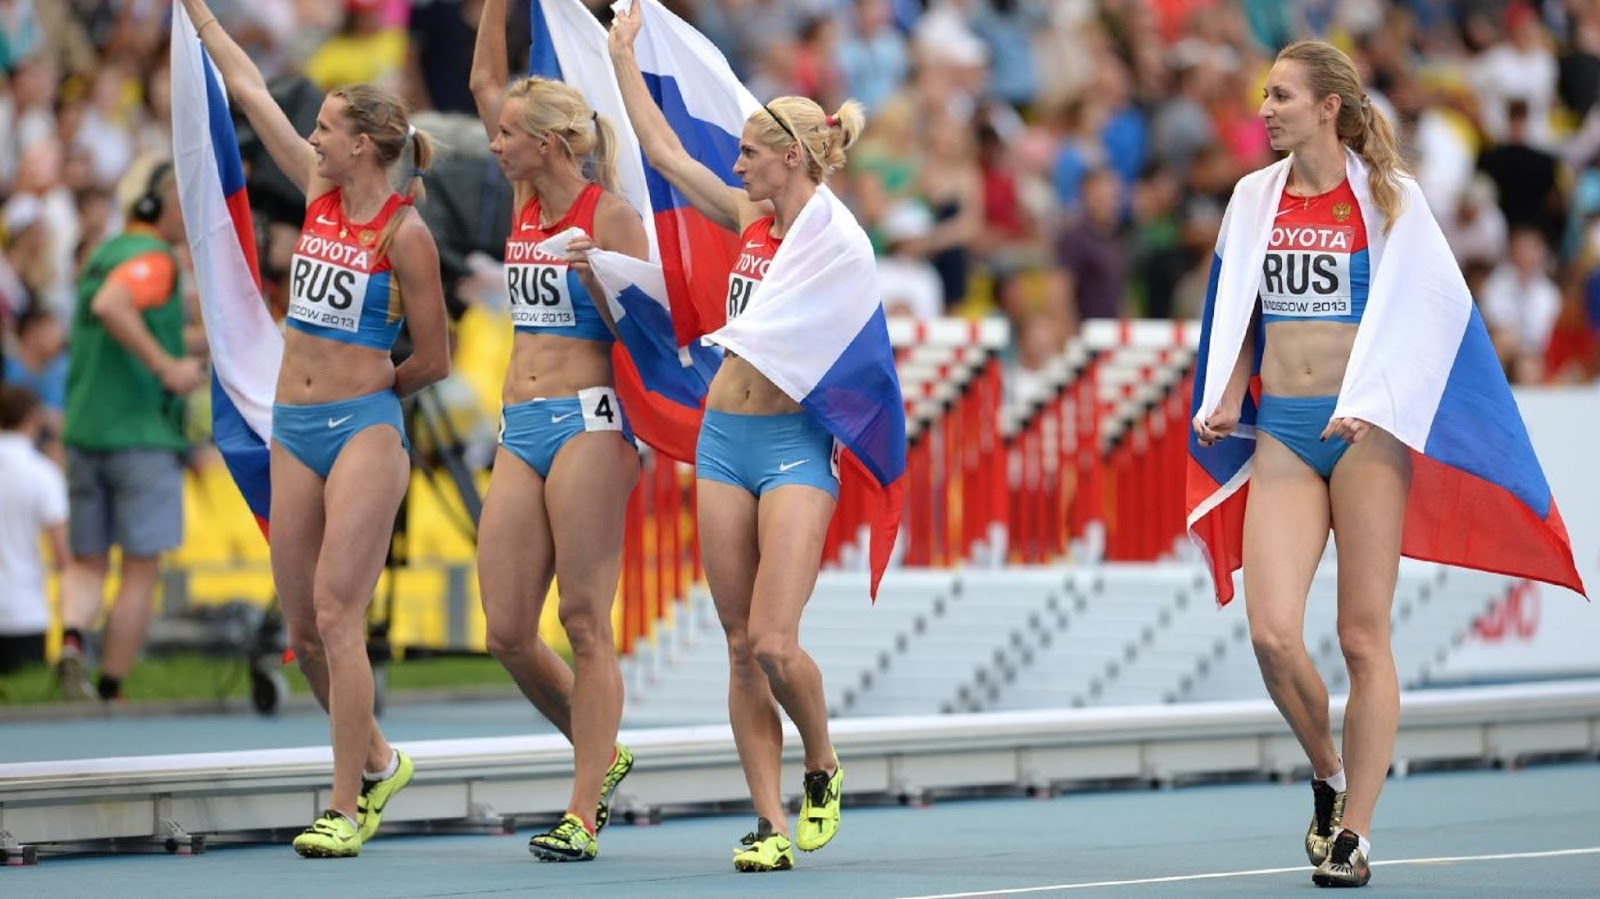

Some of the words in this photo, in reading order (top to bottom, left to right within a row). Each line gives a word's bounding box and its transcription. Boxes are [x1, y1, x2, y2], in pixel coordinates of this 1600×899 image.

[1269, 228, 1346, 249] OYOTA
[300, 234, 368, 270] TOYOTA
[507, 242, 557, 261] TOYO
[735, 252, 772, 277] TOYO
[1263, 253, 1339, 295] RUS
[293, 258, 355, 310] RUS
[508, 267, 560, 306] RUS
[541, 312, 571, 323] 2013
[1312, 302, 1347, 312] 2013
[321, 313, 355, 329] 2013
[594, 394, 614, 423] 4
